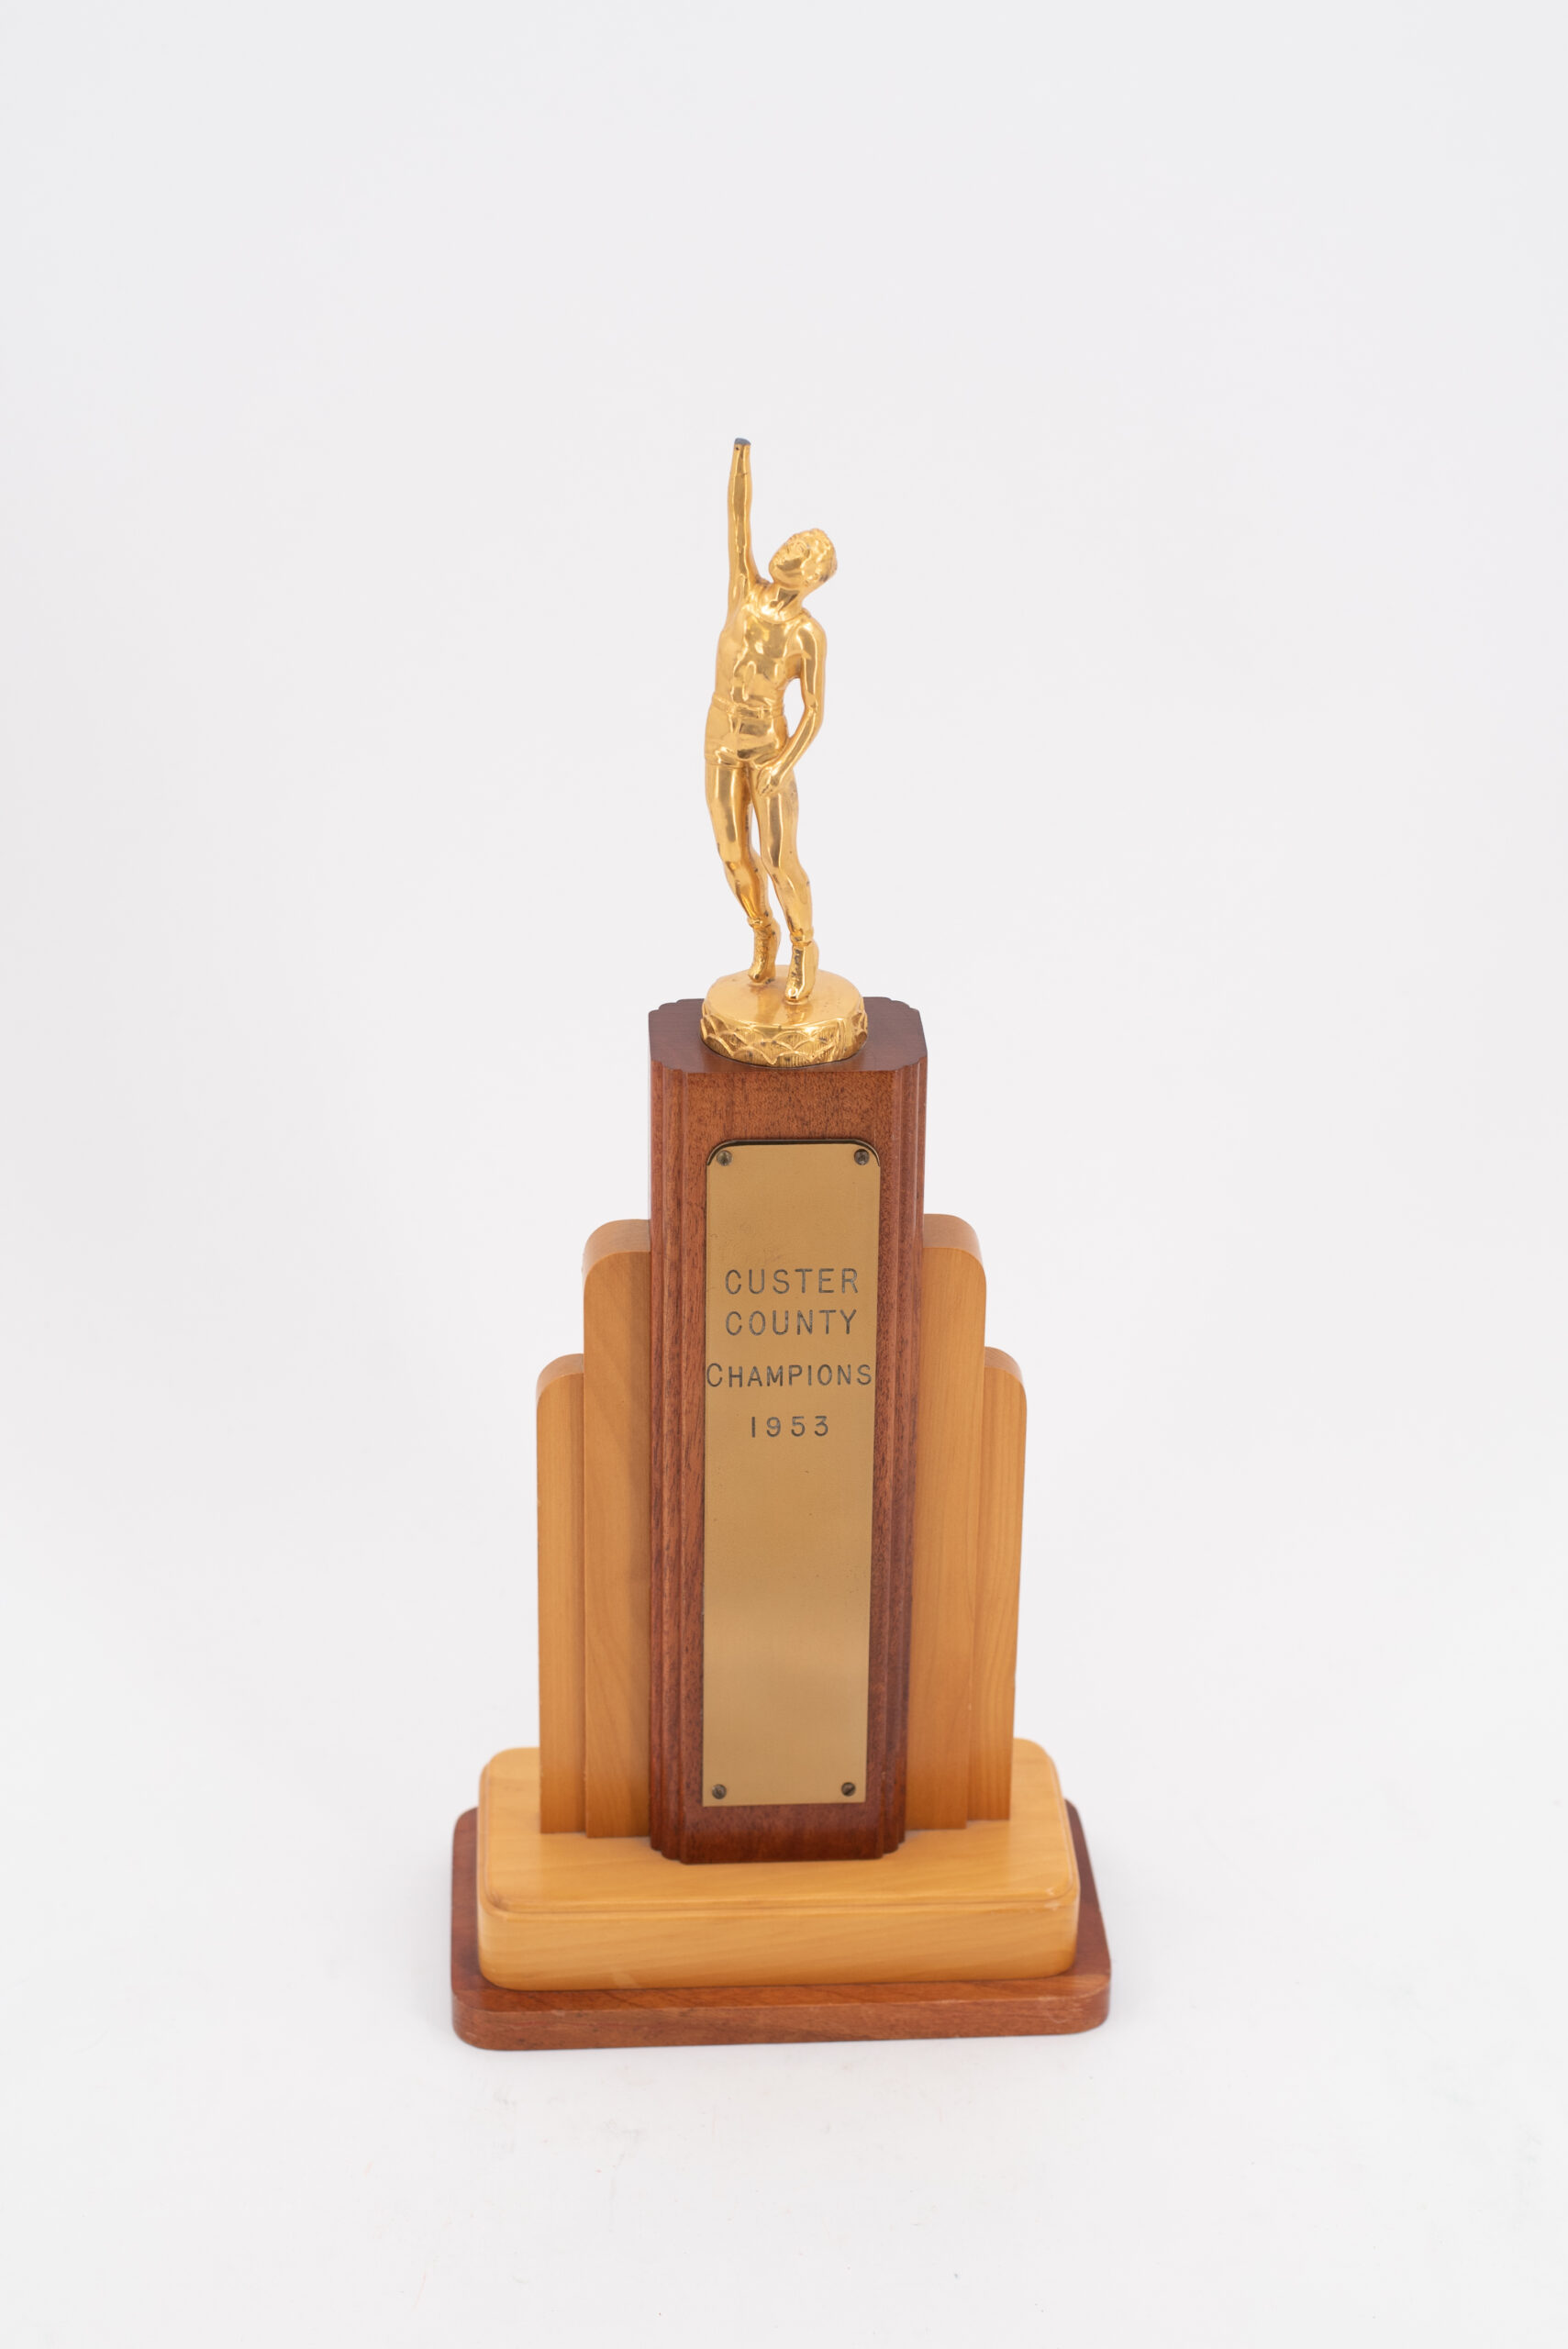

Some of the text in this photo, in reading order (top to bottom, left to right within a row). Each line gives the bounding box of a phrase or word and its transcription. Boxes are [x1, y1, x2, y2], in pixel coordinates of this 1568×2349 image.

[725, 1267, 859, 1295] CUSTER
[725, 1308, 857, 1336] COUNTY
[706, 1363, 872, 1387] CHAMPIONS
[751, 1415, 828, 1438] 1953
